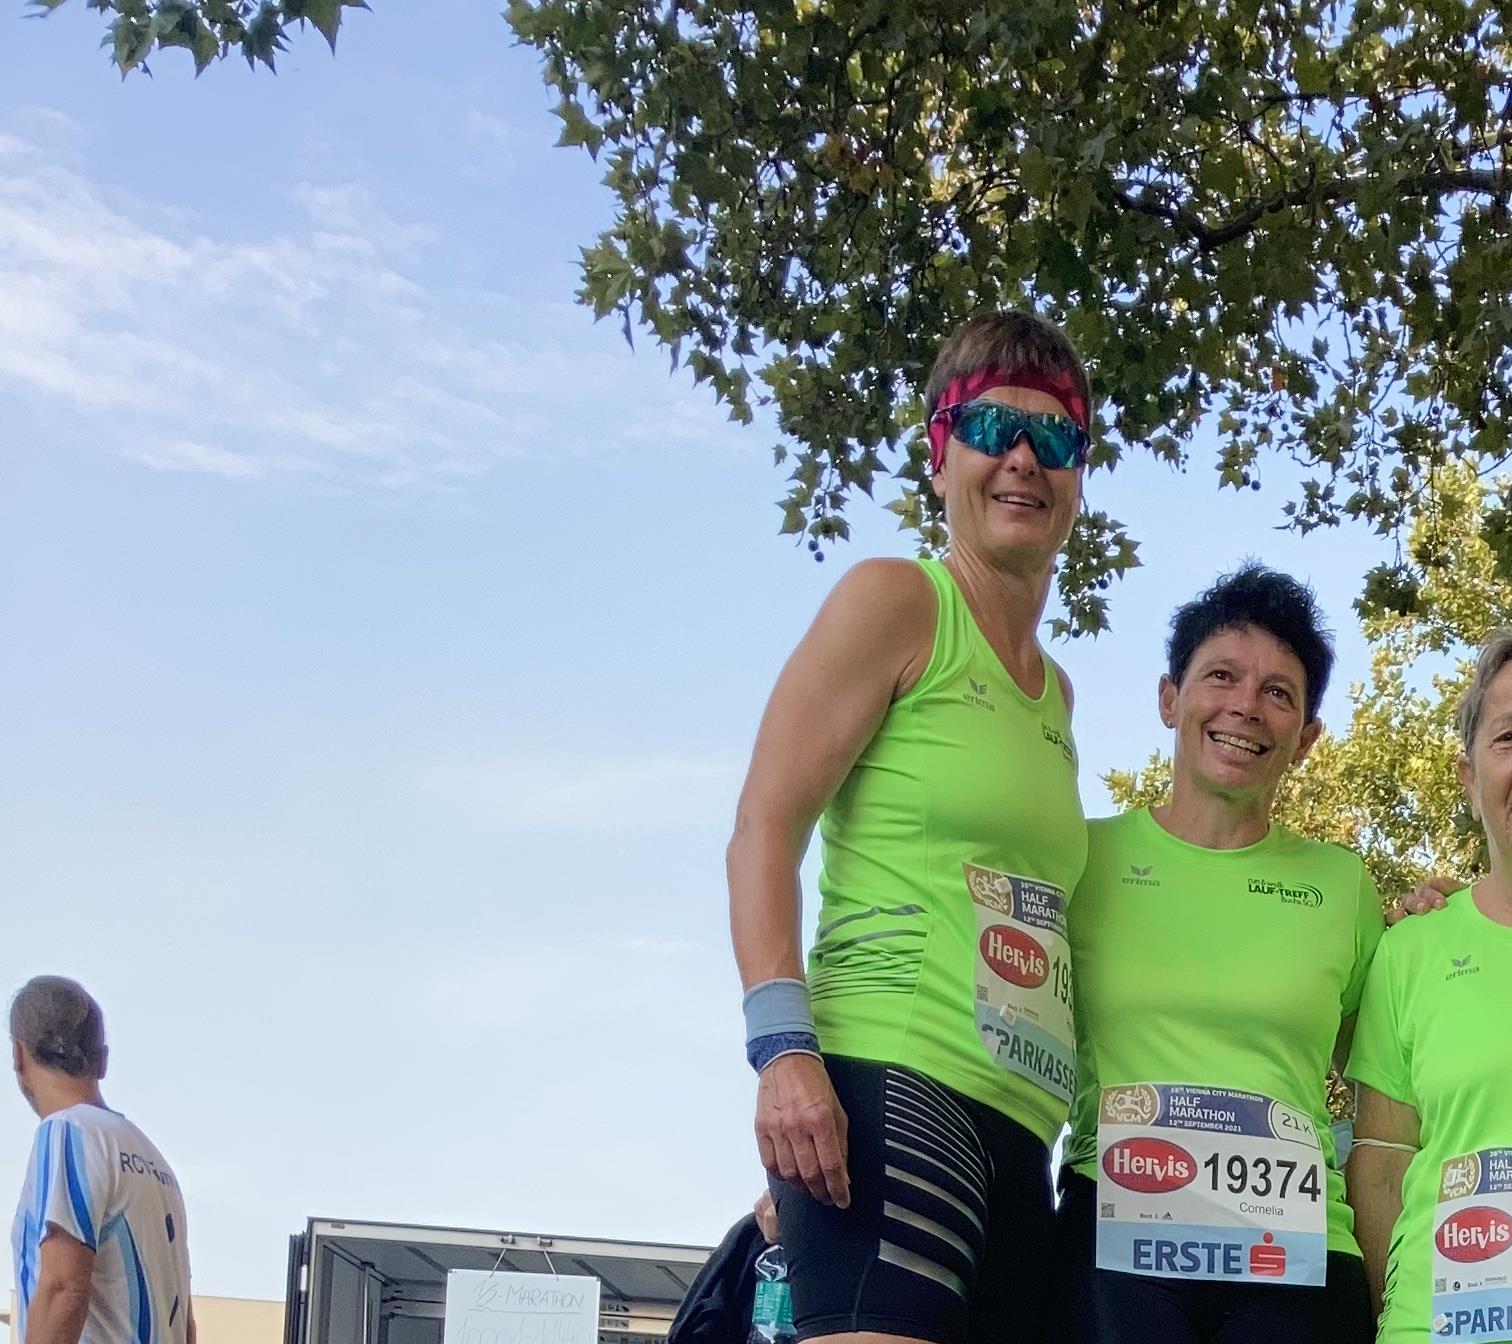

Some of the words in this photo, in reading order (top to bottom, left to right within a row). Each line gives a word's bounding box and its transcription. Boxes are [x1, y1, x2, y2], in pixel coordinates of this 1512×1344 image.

[1021, 891, 1048, 905] HALF
[1248, 884, 1309, 899] LAUF-TREFF
[988, 931, 1045, 977] Hervis
[1212, 1089, 1226, 1098] CITY
[1170, 1096, 1200, 1107] HALF
[1117, 1112, 1142, 1123] VCM
[1169, 1107, 1235, 1122] MARATHON
[1184, 1121, 1223, 1131] SEPTEMBER
[1113, 1148, 1190, 1181] Hervis
[1204, 1153, 1321, 1202] 19374
[1240, 1202, 1284, 1216] Cornelia
[1443, 1220, 1511, 1249] Hervis
[1133, 1239, 1243, 1275] ERSTE
